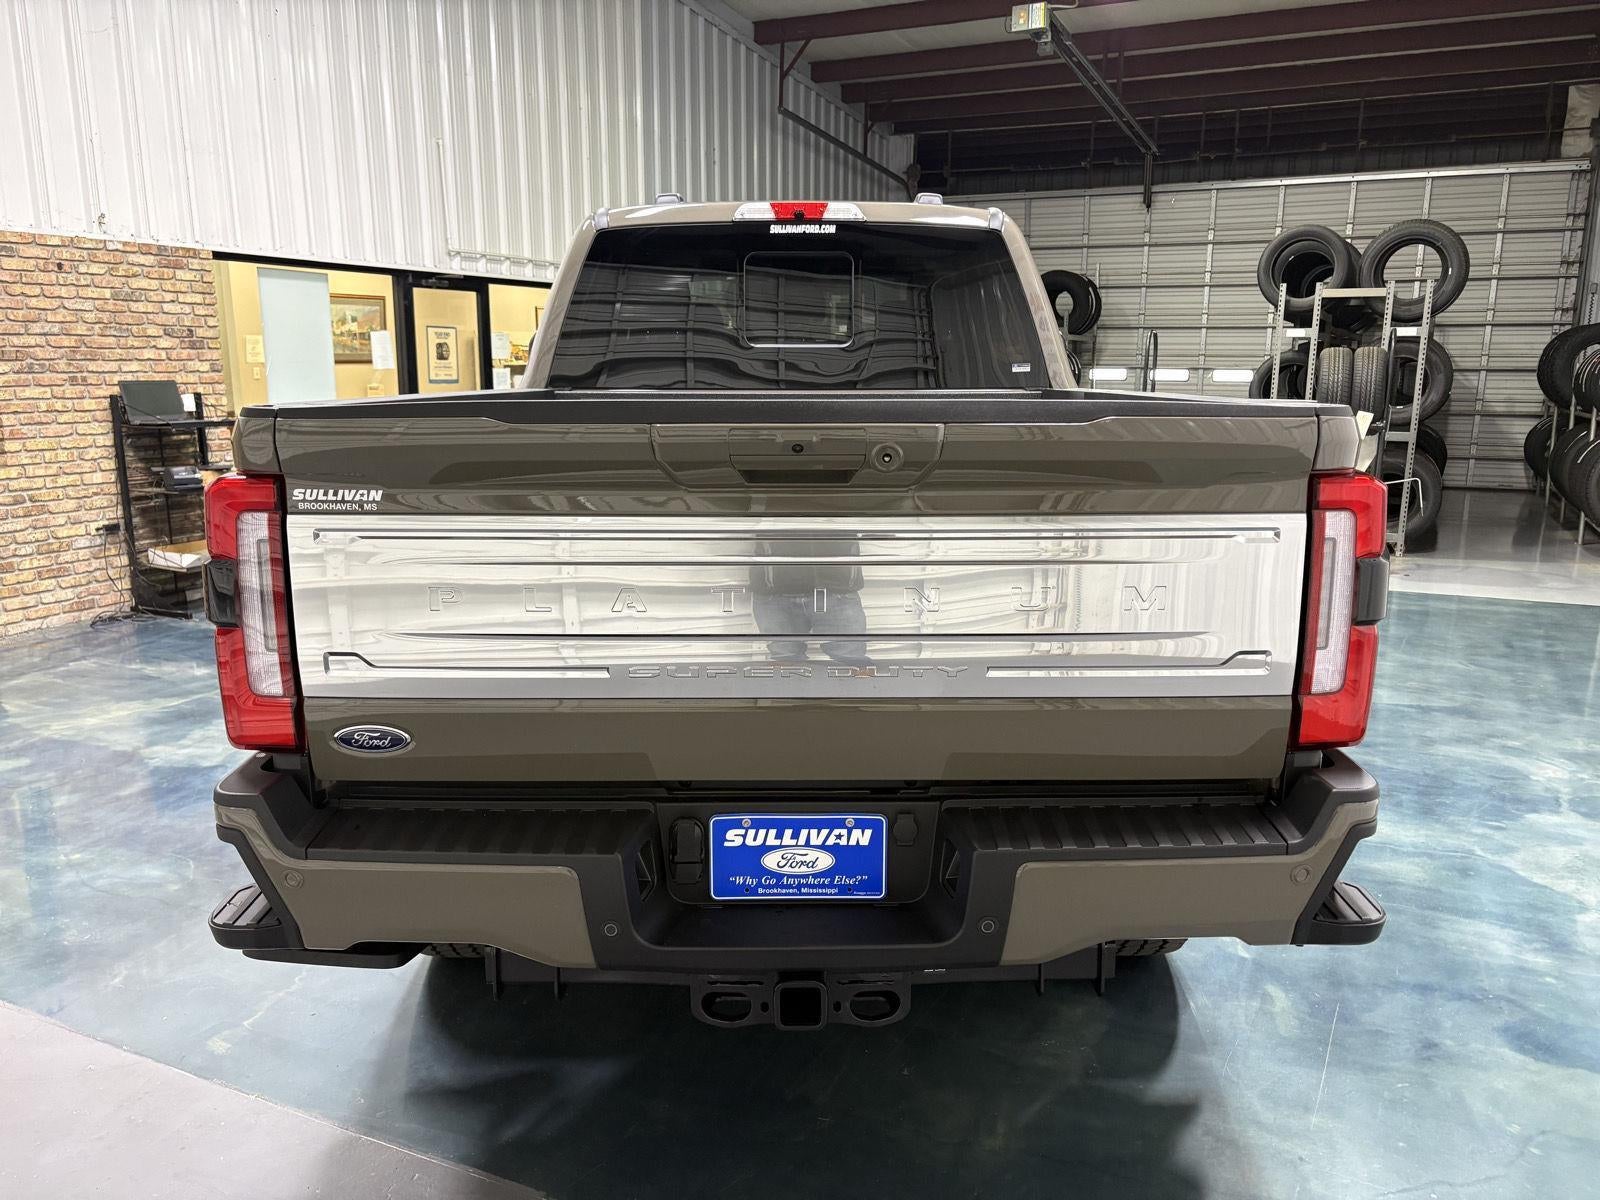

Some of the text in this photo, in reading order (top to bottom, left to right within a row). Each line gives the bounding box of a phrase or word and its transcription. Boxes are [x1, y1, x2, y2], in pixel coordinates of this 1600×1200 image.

[769, 224, 837, 234] SULLIVANFORD.COM
[292, 488, 383, 501] SULLIVAN
[298, 502, 378, 511] BROOKHAVEN, MS
[428, 585, 1167, 613] PLATINUM
[628, 665, 969, 679] SUPER DUTY
[351, 731, 392, 748] Ford
[723, 828, 873, 847] SULLIVAN
[776, 851, 819, 870] Ford
[761, 875, 777, 886] Go
[779, 875, 831, 888] Anywhere
[757, 886, 839, 895] Brookhaven, Mississippi
